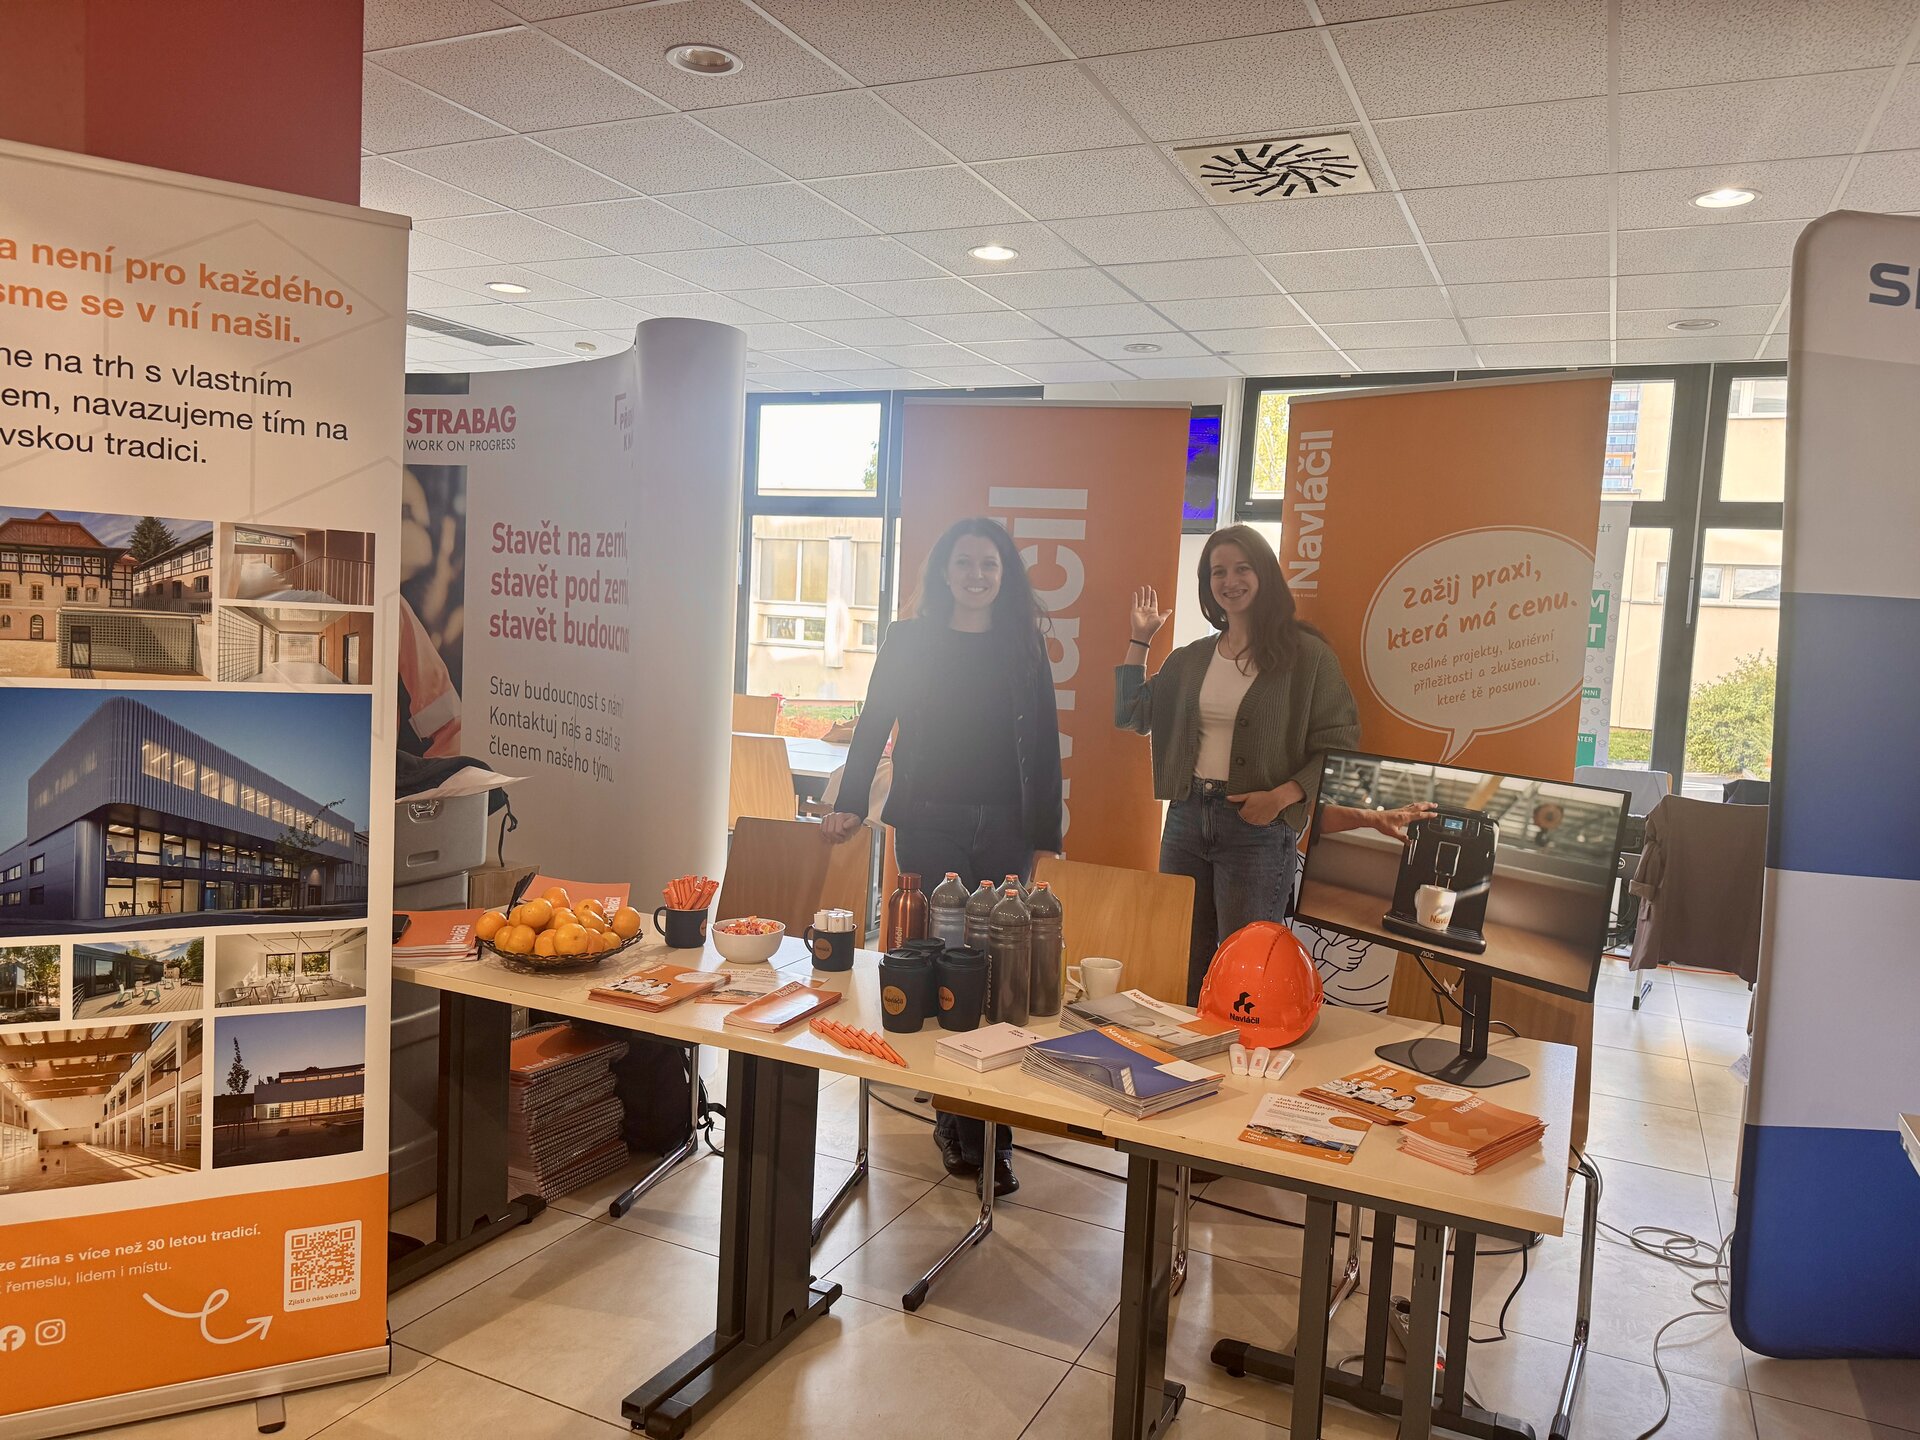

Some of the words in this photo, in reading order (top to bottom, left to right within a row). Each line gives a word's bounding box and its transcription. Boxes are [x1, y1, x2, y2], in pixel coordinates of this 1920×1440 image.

[32, 242, 115, 275] není
[126, 257, 186, 285] pro
[200, 263, 353, 315] každého,
[81, 293, 124, 318] se
[136, 302, 156, 323] v
[168, 301, 202, 330] ní
[211, 311, 300, 343] našli.
[45, 352, 82, 374] na
[93, 353, 134, 380] trh
[145, 364, 162, 383] s
[172, 365, 292, 398] vlastním
[73, 394, 253, 430] navazujeme
[262, 410, 305, 436] tím
[316, 420, 348, 441] na
[407, 405, 517, 434] STRABAG
[105, 432, 207, 463] tradici.
[406, 440, 443, 452] WORK
[447, 440, 465, 451] ON
[469, 438, 516, 451] PROGRESS
[1286, 430, 1333, 590] Navláčil
[491, 520, 560, 555] Stavět
[568, 531, 591, 556] na
[491, 564, 558, 599] stavět
[565, 570, 600, 608] pod
[1402, 574, 1460, 609] Zažij
[1472, 554, 1542, 599] praxi,
[489, 607, 557, 642] stavět
[1387, 614, 1448, 650] která
[1459, 601, 1497, 633] má
[1508, 591, 1578, 620] cenu.
[1410, 655, 1447, 673] Reálné
[1453, 645, 1503, 667] projekty,
[1508, 629, 1555, 650] kariérní
[1413, 669, 1473, 694] příležitosti
[1478, 669, 1485, 677] a
[1491, 650, 1559, 675] zkušenosti,
[490, 676, 520, 698] Stav
[525, 679, 598, 711] budoucnost
[601, 696, 606, 712] s
[1437, 691, 1466, 707] které
[1471, 686, 1484, 699] tě
[1488, 678, 1541, 698] posunou.
[490, 706, 557, 738] Kontaktuj
[561, 718, 581, 740] nás
[585, 727, 592, 742] a
[596, 726, 613, 747] staň
[489, 734, 542, 762] členem
[546, 746, 589, 774] našeho
[593, 756, 614, 783] týmu.
[1229, 1012, 1260, 1024] Navláčil
[21, 1254, 60, 1269] Zlína
[65, 1252, 74, 1263] s
[79, 1246, 110, 1261] více
[115, 1241, 143, 1256] než
[147, 1238, 165, 1252] 30
[170, 1233, 207, 1248] letou
[210, 1223, 261, 1242] tradicí.
[6, 1275, 71, 1294] řemeslu,
[76, 1268, 116, 1283] lidem
[121, 1266, 125, 1277] i
[128, 1261, 172, 1276] místu.
